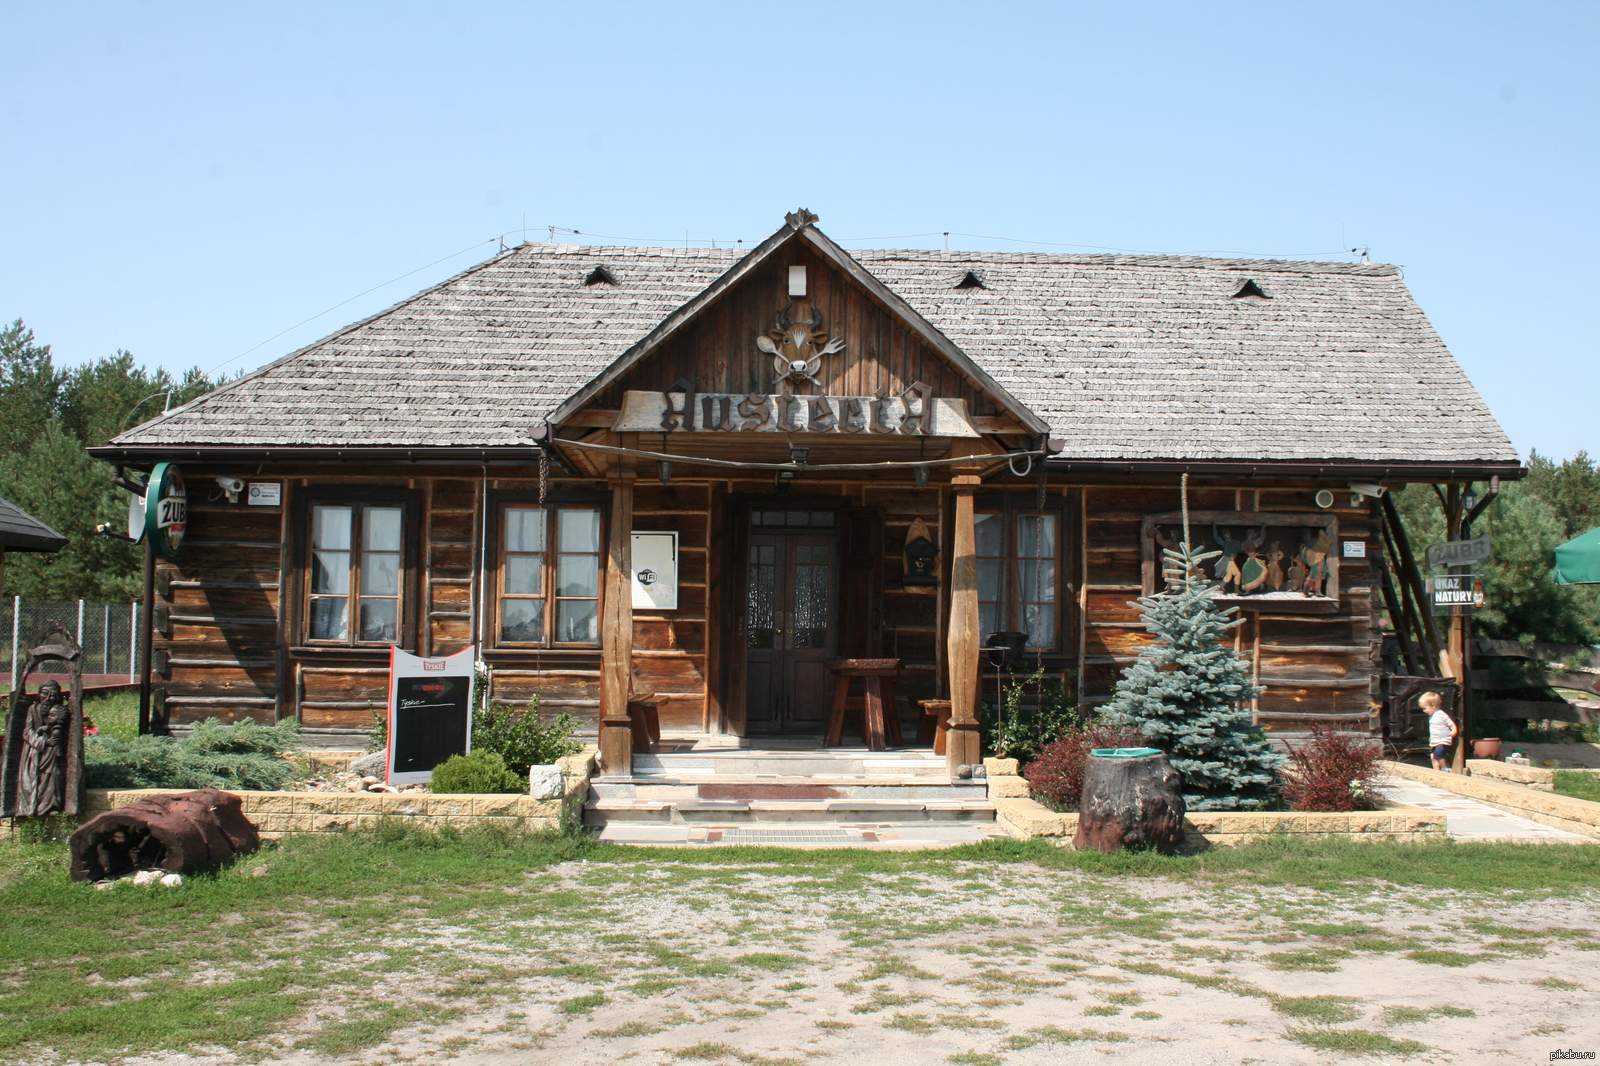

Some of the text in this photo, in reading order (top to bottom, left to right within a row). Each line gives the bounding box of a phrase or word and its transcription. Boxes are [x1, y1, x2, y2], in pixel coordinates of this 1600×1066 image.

[162, 501, 186, 524] ŻUB
[1434, 578, 1459, 589] OKAZ
[1435, 591, 1472, 602] NATURY
[424, 662, 445, 670] TYSKIE
